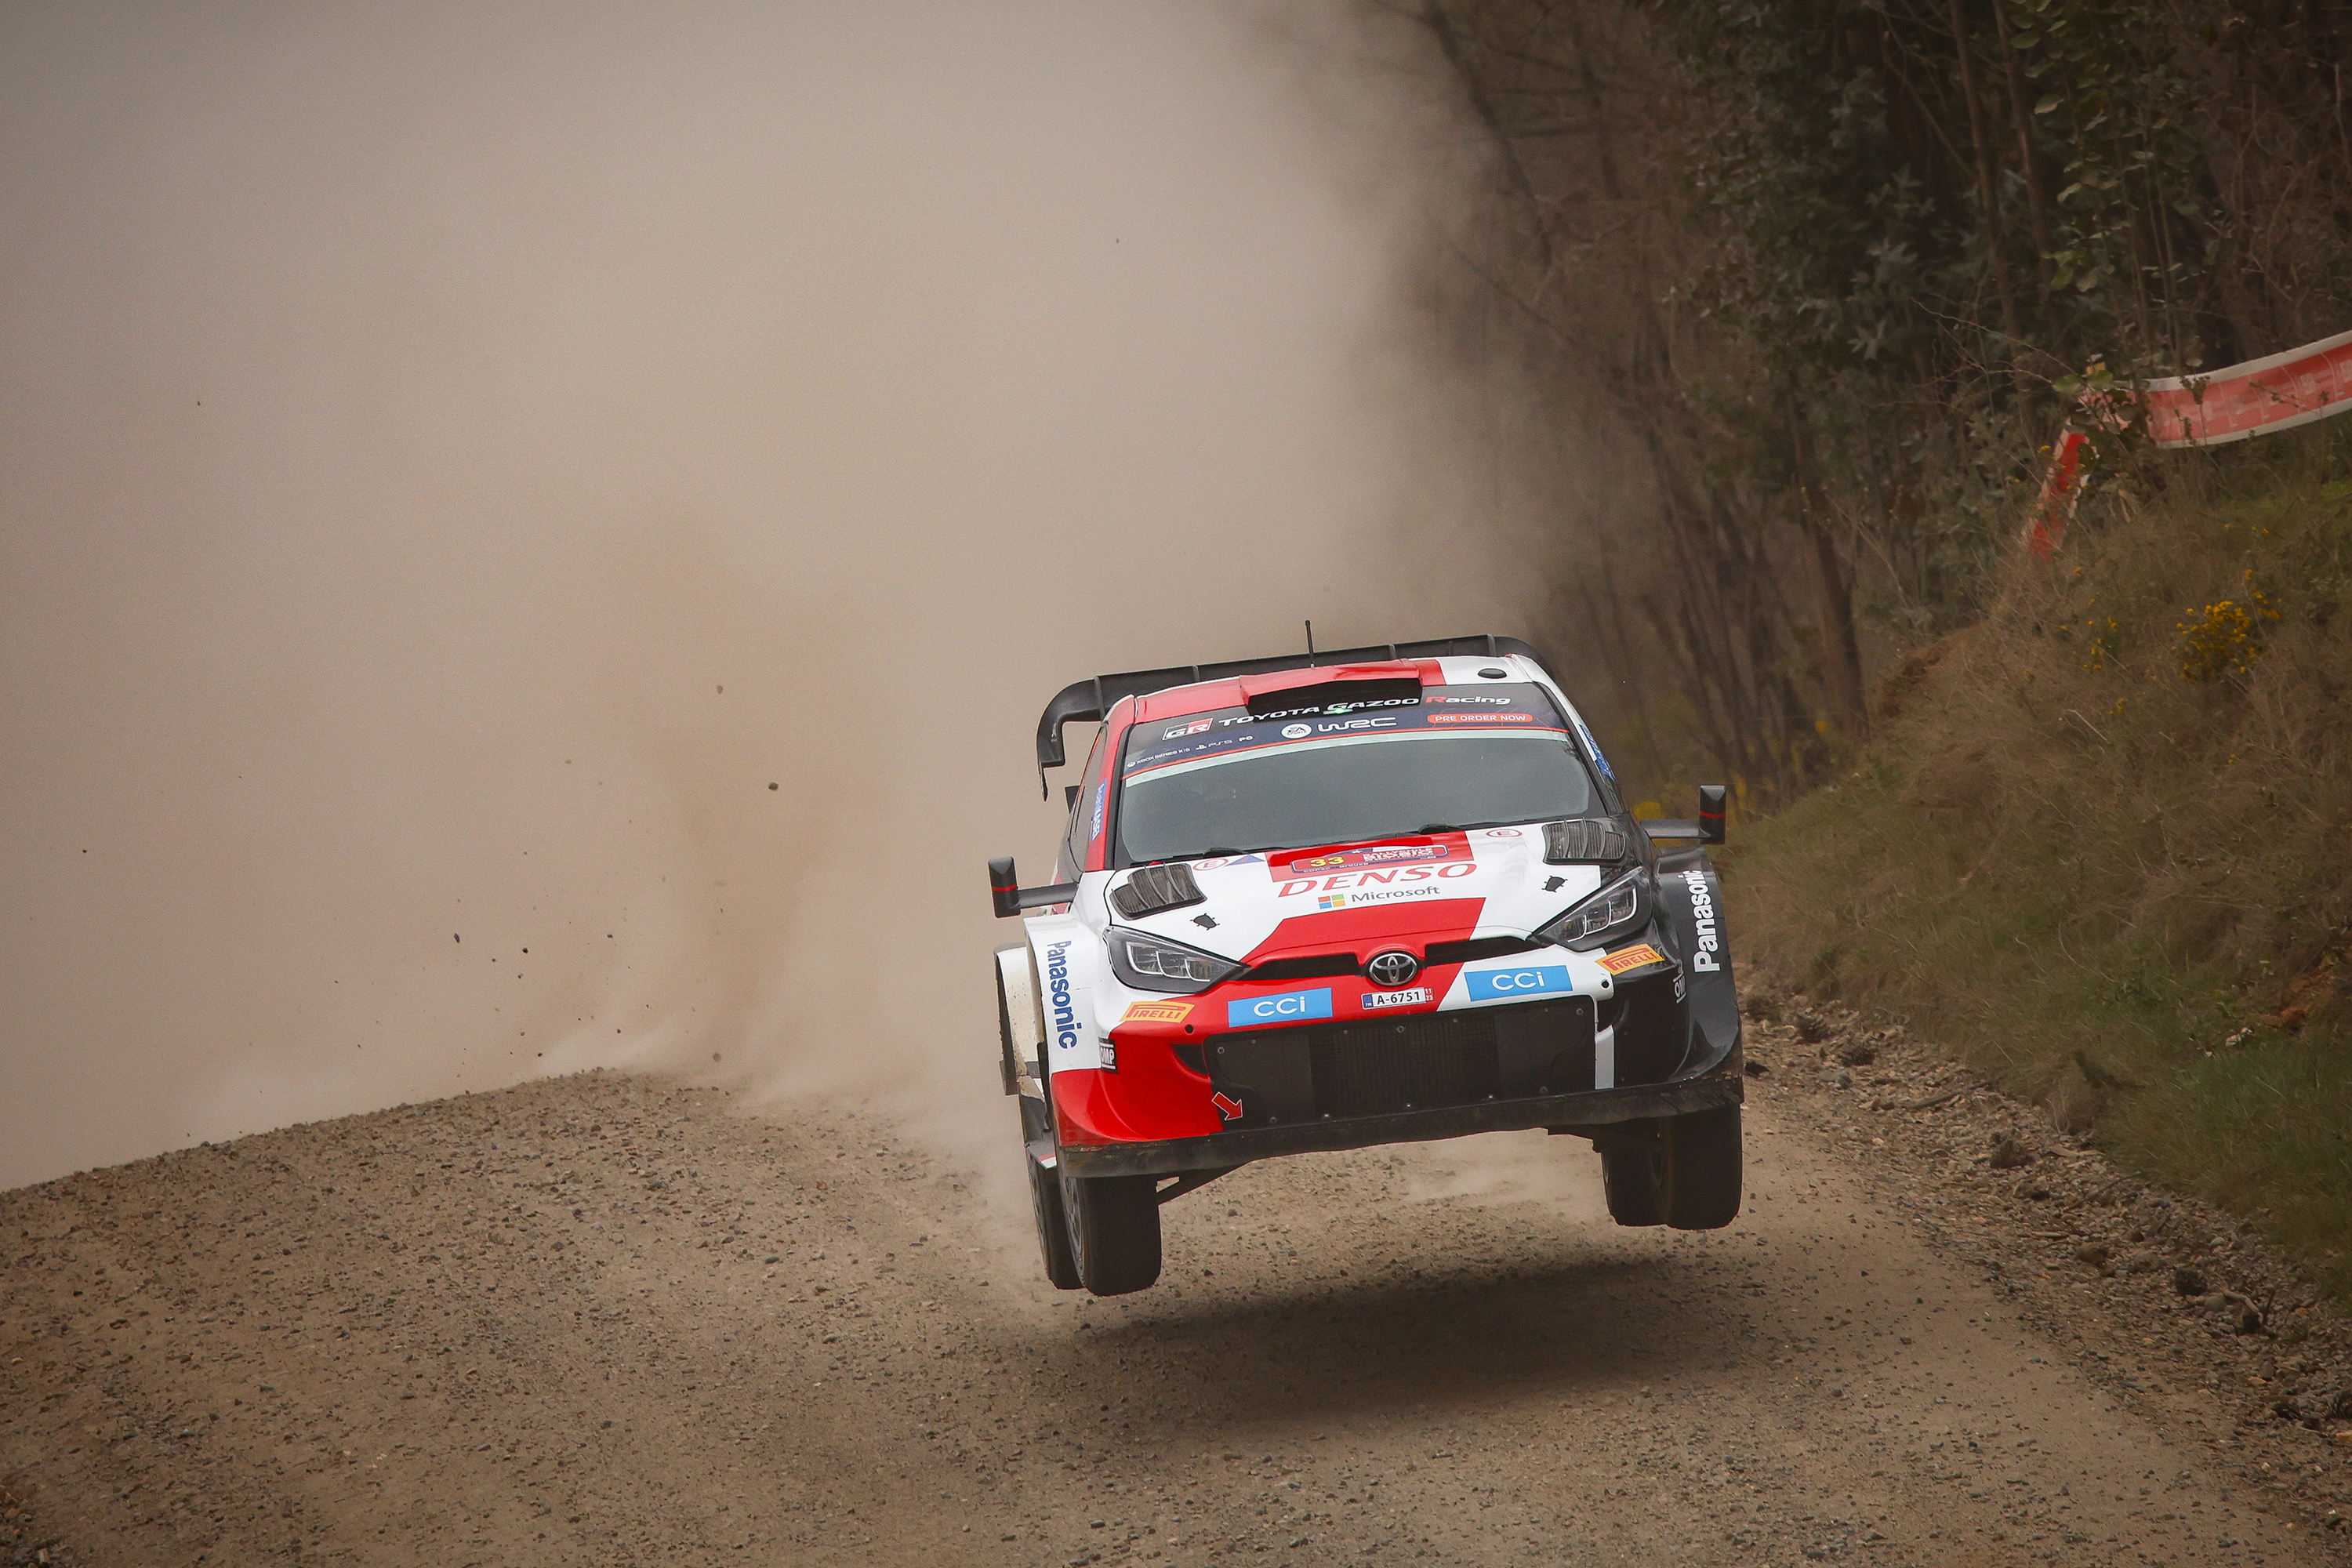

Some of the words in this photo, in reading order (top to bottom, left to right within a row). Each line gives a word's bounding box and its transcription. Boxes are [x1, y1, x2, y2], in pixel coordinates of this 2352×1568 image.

[1165, 723, 1210, 739] GR
[1218, 706, 1320, 727] TOYOTA
[1327, 698, 1420, 712] GAZOO
[1425, 696, 1512, 705] Racing
[1318, 717, 1397, 732] WRC
[1309, 856, 1345, 867] 33
[1278, 863, 1477, 898] DENSO
[1351, 885, 1441, 902] Microsoft
[1678, 869, 1721, 973] Panasonic
[1602, 947, 1657, 971] PIRELLI
[1047, 940, 1083, 1050] Panasonic
[1377, 991, 1420, 1005] A-6751
[1126, 1004, 1187, 1019] PIRELLI
